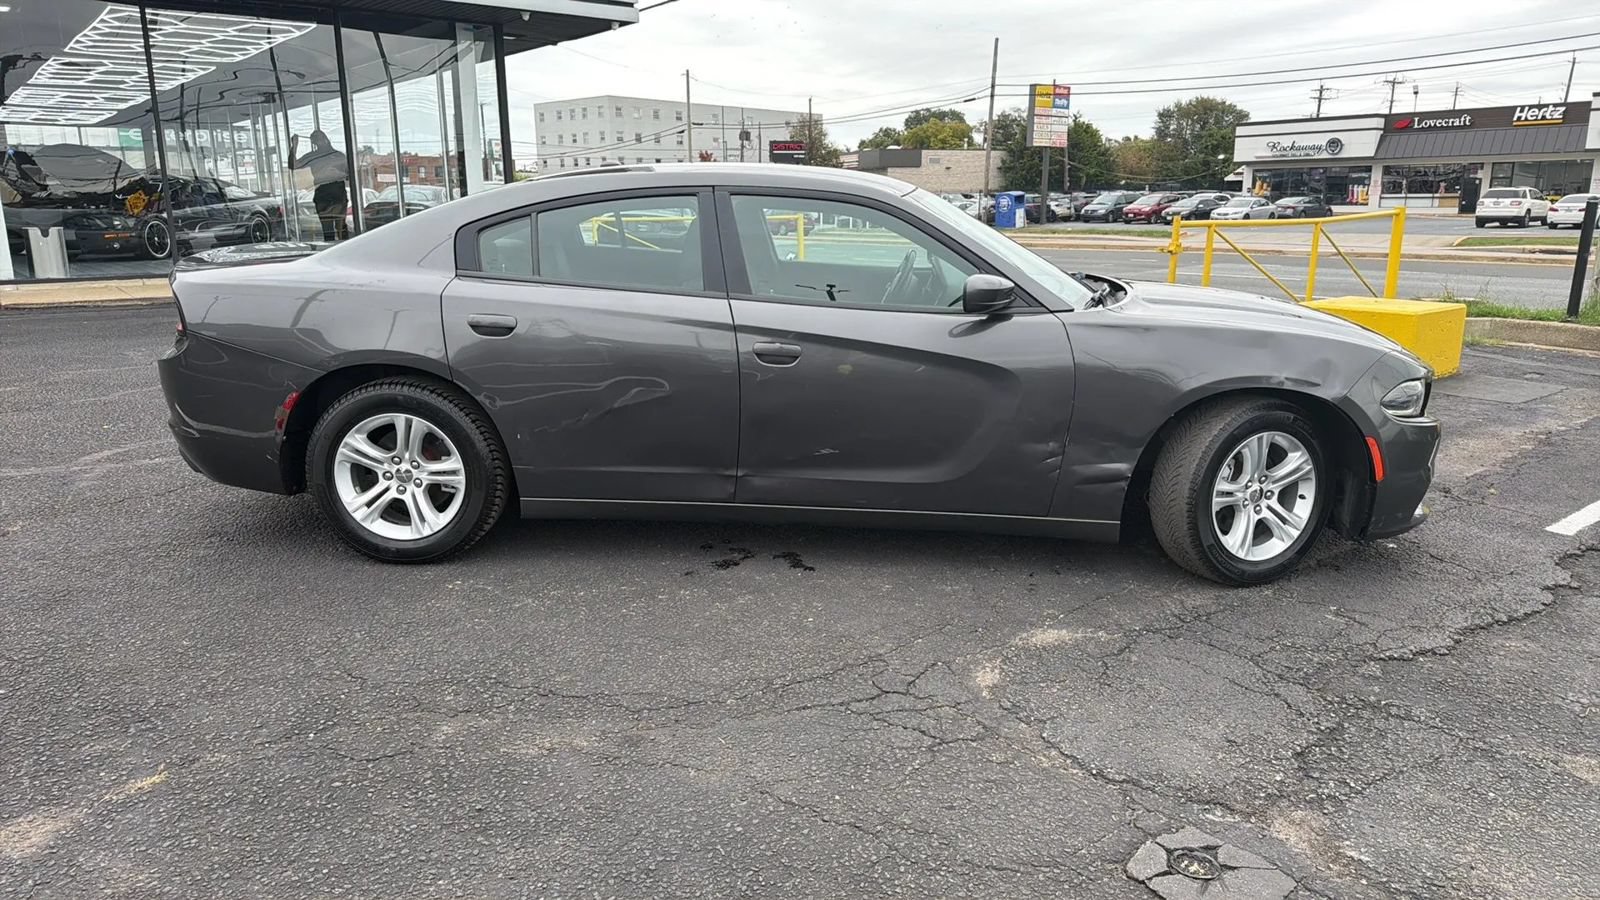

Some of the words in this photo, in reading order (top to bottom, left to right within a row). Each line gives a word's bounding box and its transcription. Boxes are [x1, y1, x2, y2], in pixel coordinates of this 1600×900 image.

[1512, 104, 1566, 121] Hertz
[1413, 114, 1472, 129] Lovecraft
[1266, 140, 1325, 154] Rockaway
